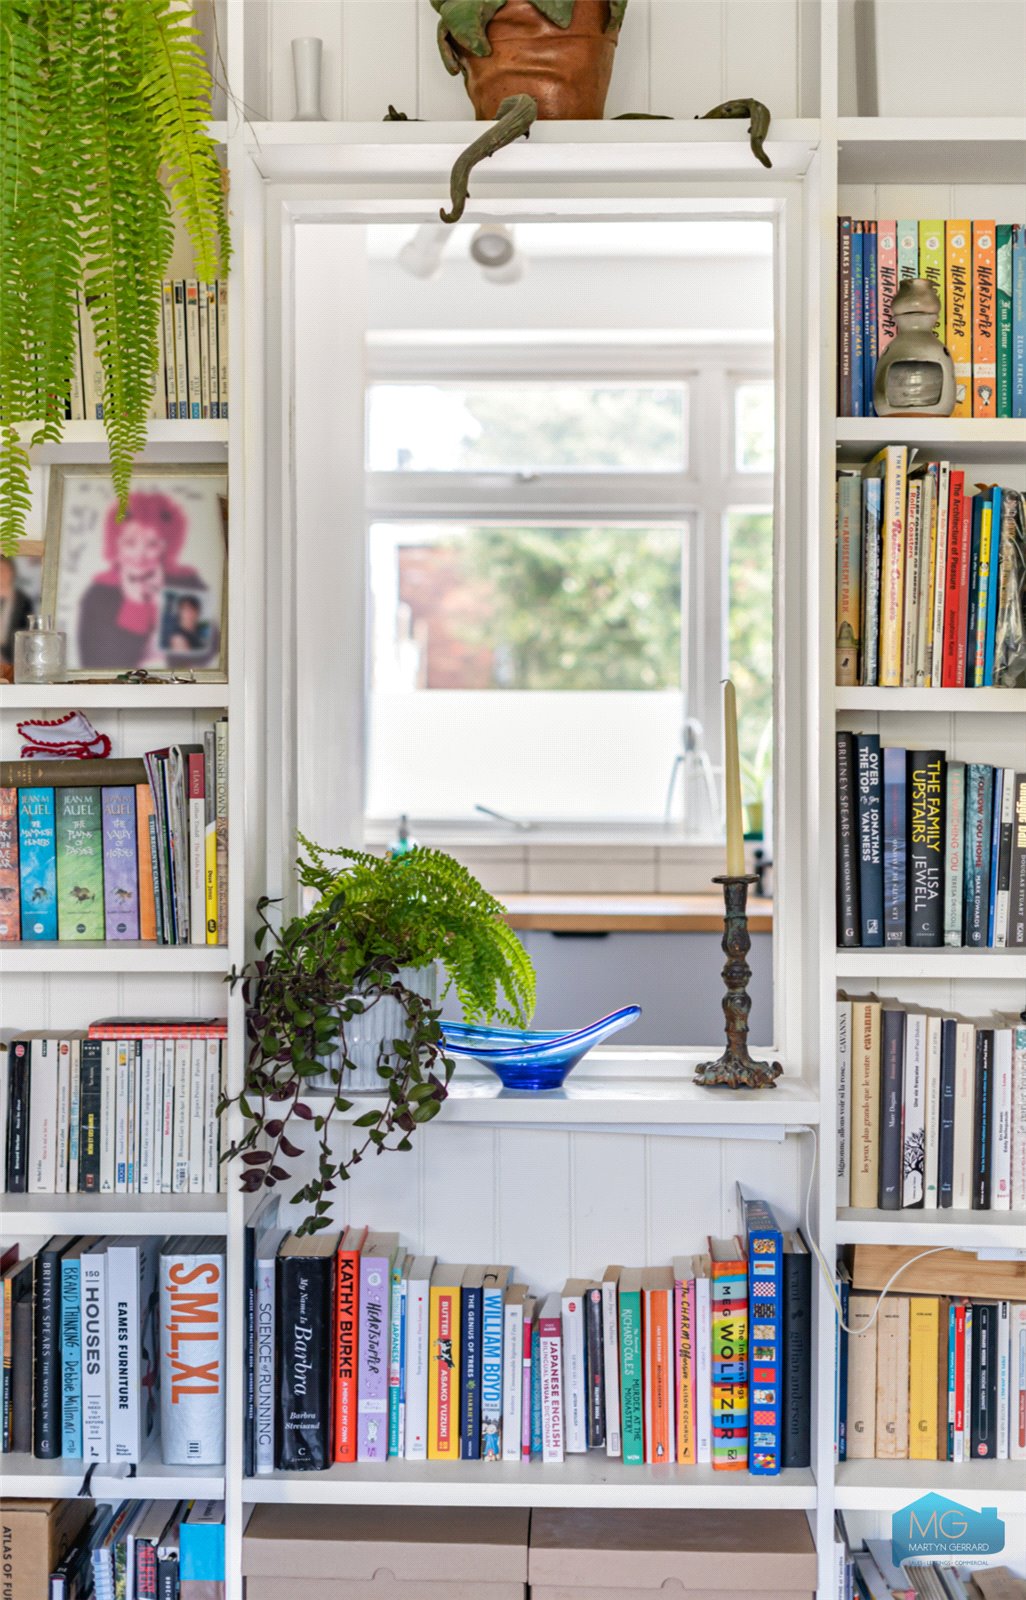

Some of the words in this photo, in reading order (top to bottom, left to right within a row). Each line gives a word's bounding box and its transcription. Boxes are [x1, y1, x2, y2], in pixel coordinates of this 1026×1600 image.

[951, 265, 967, 337] HEARTSTOPPER
[977, 266, 992, 338] HEARTSTOPPER
[1000, 299, 1010, 320] Fun
[1000, 322, 1010, 348] Home
[953, 483, 961, 498] The
[951, 499, 961, 544] Architecture
[907, 522, 915, 559] Coasters
[951, 545, 958, 556] of
[949, 557, 957, 590] Pleasure
[841, 588, 849, 613] PARK
[948, 610, 956, 641] Josephine
[217, 736, 226, 778] KENTISH
[838, 741, 848, 791] BRITNEY
[859, 746, 868, 770] THE
[869, 753, 878, 786] OVER
[859, 771, 869, 793] TOP
[927, 761, 940, 792] THE
[20, 804, 51, 815] AUEL
[63, 804, 94, 815] AUEL
[64, 795, 82, 804] JEAN
[84, 795, 93, 803] M
[217, 783, 226, 815] TOWN
[912, 770, 926, 843] UPSTAIRS
[977, 776, 985, 814] FOLLOW
[840, 795, 849, 837] SPEARS
[862, 811, 870, 833] VAN
[927, 798, 939, 852] FAMILY
[862, 834, 871, 861] NESS
[871, 808, 879, 864] JONATHAN
[975, 840, 983, 868] HOME
[845, 894, 851, 903] IN
[912, 854, 926, 912] JEWELL
[927, 868, 939, 900] LISA
[846, 906, 852, 917] ME
[846, 928, 854, 937] G
[862, 1005, 871, 1050] cavanna
[863, 1087, 872, 1101] que
[862, 1102, 871, 1127] grands
[862, 1128, 871, 1142] plus
[838, 1139, 846, 1177] Mignonne,
[863, 1145, 872, 1162] yeux
[42, 1262, 51, 1311] BRITNEY
[63, 1267, 80, 1302] BRAND
[298, 1278, 308, 1290] My
[340, 1259, 354, 1315] KATHY
[680, 1286, 689, 1298] The
[791, 1270, 801, 1301] want
[299, 1292, 307, 1315] Name
[441, 1301, 449, 1335] BUTTER
[722, 1286, 731, 1317] MEG
[42, 1315, 51, 1356] SPEARS
[63, 1305, 80, 1348] THINKING
[86, 1287, 101, 1375] HOUSES
[118, 1302, 128, 1341] EAMES
[165, 1263, 220, 1404] S,M,L,XL
[259, 1303, 272, 1362] SCIENCE
[299, 1316, 307, 1324] Is
[484, 1295, 501, 1358] WILLIAM
[623, 1309, 634, 1345] RICHARD
[680, 1300, 691, 1339] CHARM
[340, 1321, 354, 1378] BURKE
[366, 1302, 382, 1373] HEARTSTOPPER
[468, 1342, 474, 1353] OF
[788, 1331, 803, 1375] gillian
[64, 1360, 79, 1392] Debbie
[262, 1364, 269, 1372] of
[293, 1324, 313, 1396] Barbra
[550, 1341, 559, 1397] JAPANESE
[624, 1348, 634, 1375] COLES
[679, 1342, 692, 1379] Offensive
[737, 1344, 745, 1400] Interestings
[118, 1345, 129, 1409] FURNITURE
[440, 1369, 448, 1401] ASAKO
[483, 1364, 501, 1401] BOYD
[720, 1324, 734, 1440] WOLITZER
[258, 1374, 272, 1445] RUNNING
[624, 1388, 633, 1434] MONASTERY
[632, 1379, 640, 1412] MURDER
[791, 1378, 802, 1434] anderson
[42, 1411, 48, 1419] IN
[42, 1423, 48, 1433] ME
[64, 1395, 79, 1434] Millman
[289, 1412, 316, 1420] Barbra
[341, 1411, 348, 1421] MY
[551, 1400, 560, 1448] ENGLISH
[633, 1416, 640, 1425] AT
[633, 1427, 641, 1441] THE
[298, 1447, 305, 1455] C
